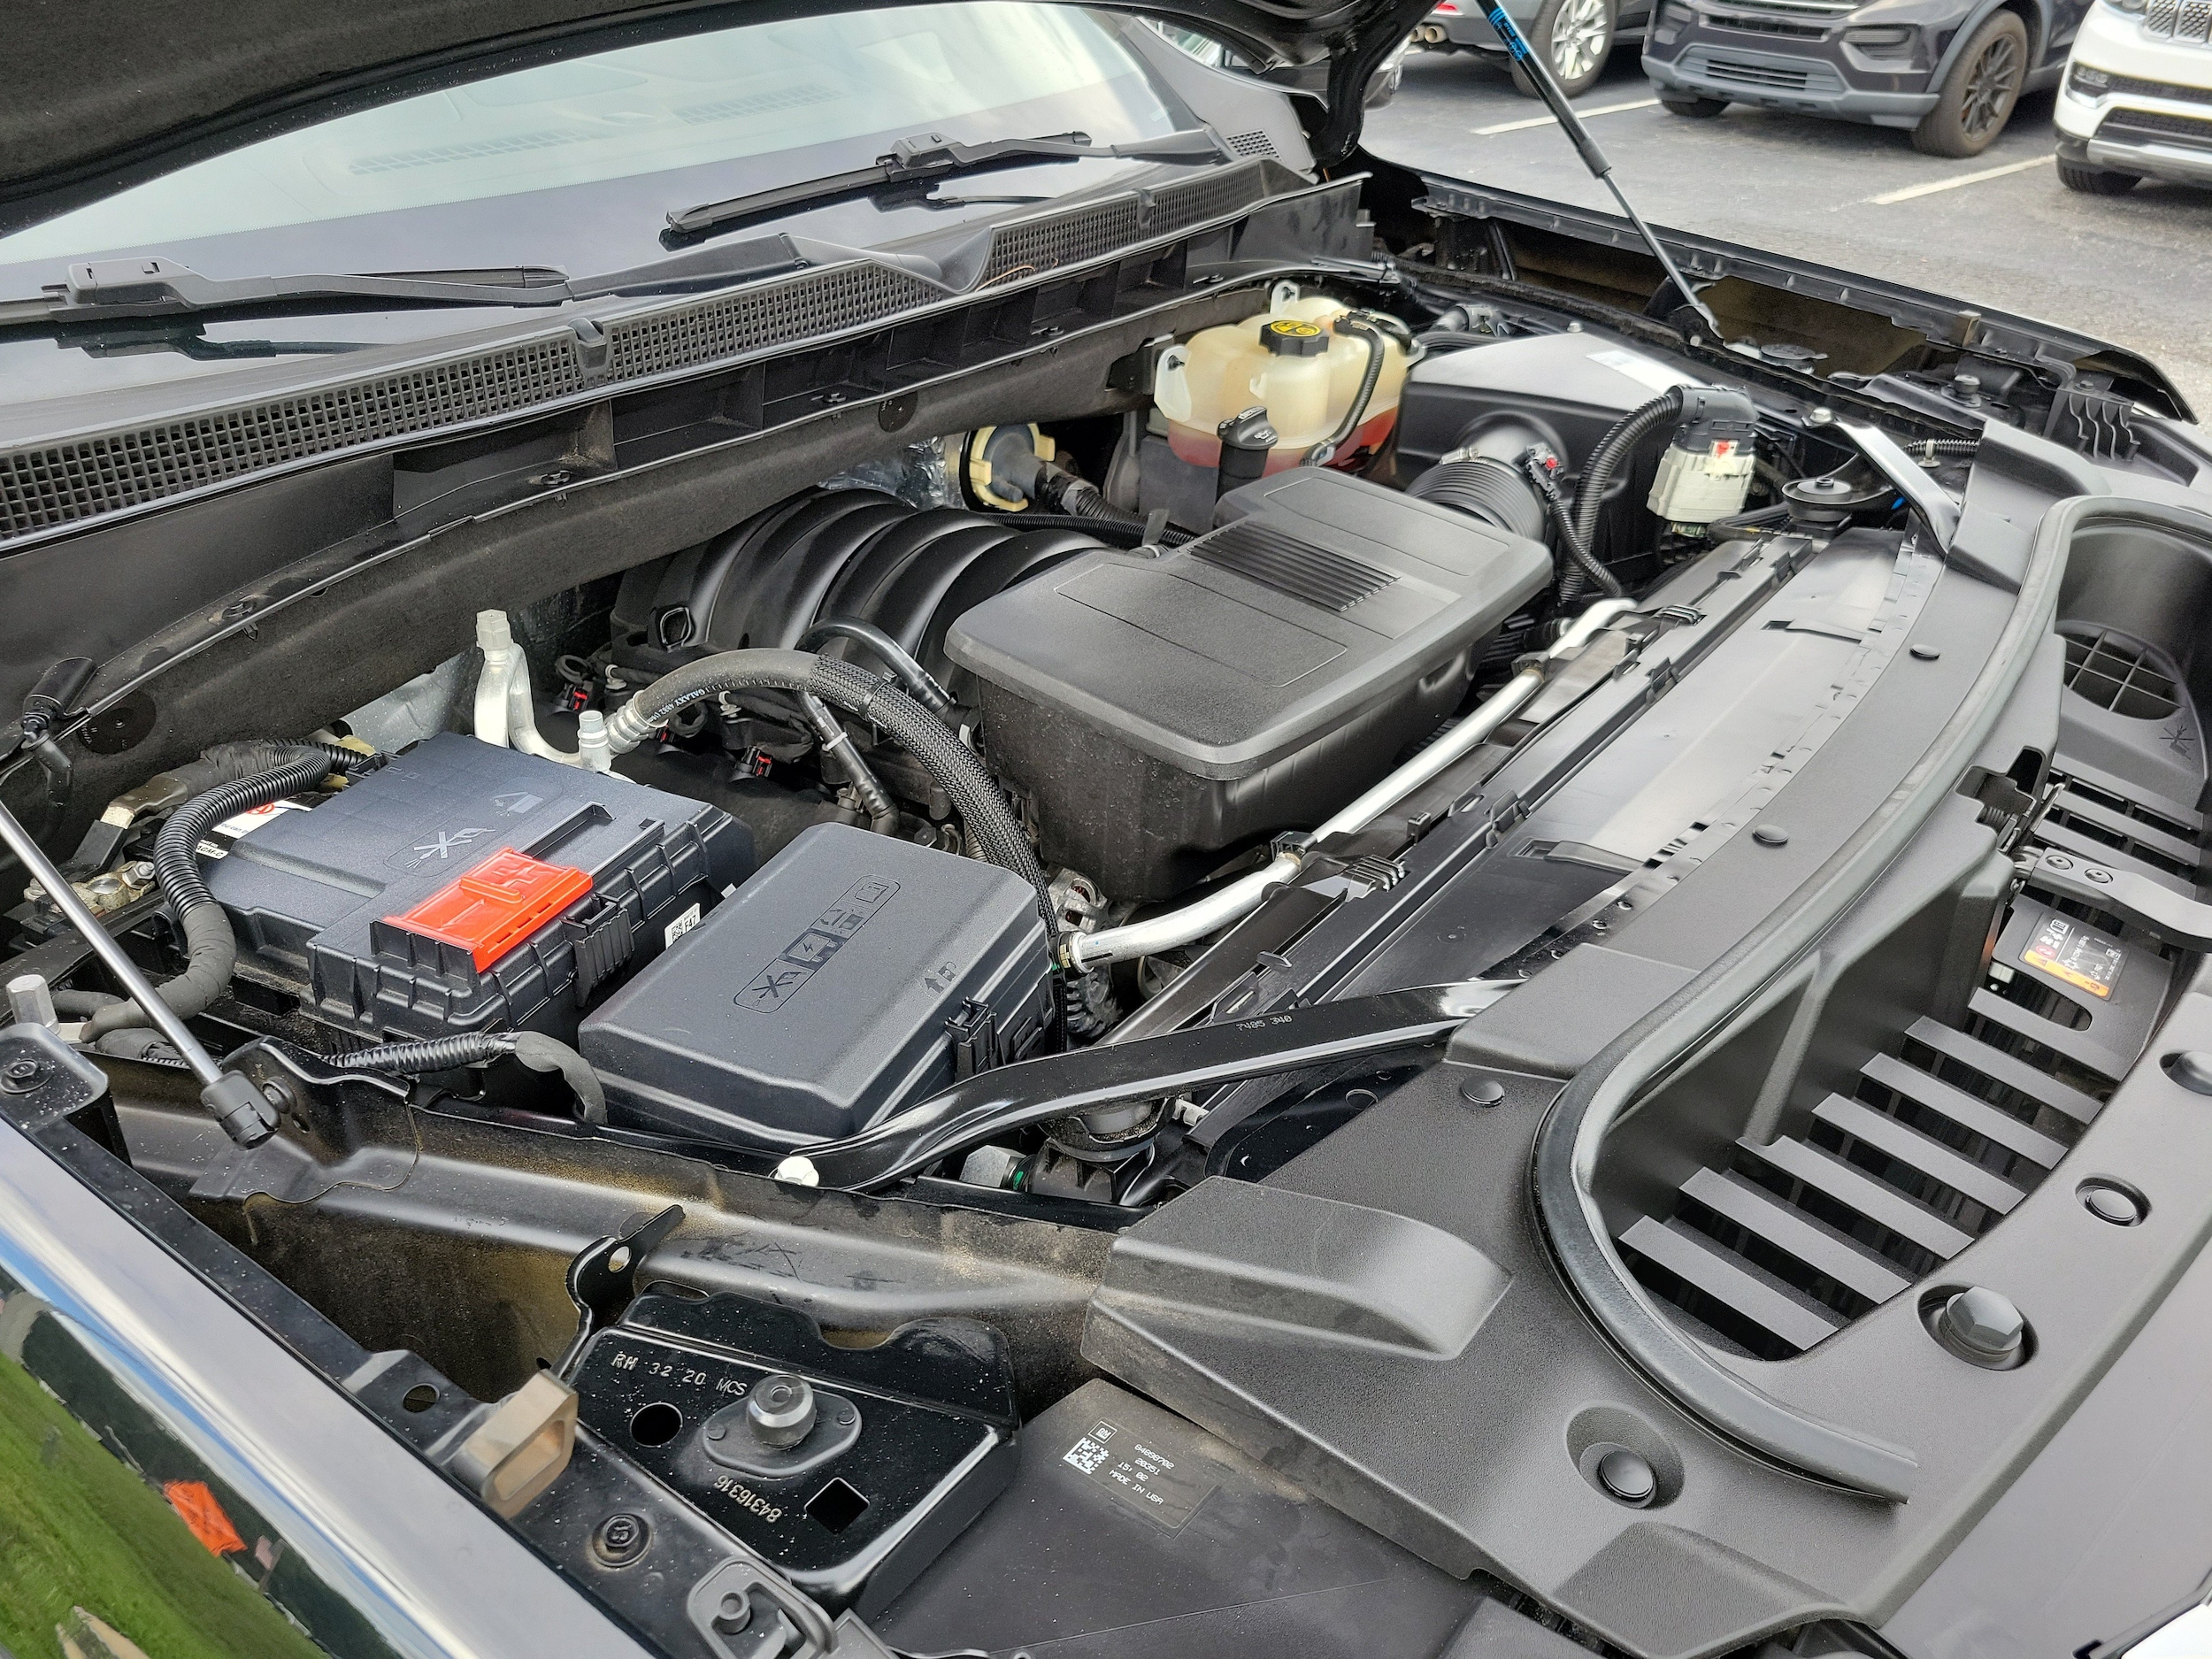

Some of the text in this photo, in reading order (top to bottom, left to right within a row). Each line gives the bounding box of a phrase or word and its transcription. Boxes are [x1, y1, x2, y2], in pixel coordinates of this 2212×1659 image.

[674, 688, 706, 706] GALAXY
[684, 915, 696, 932] F47
[611, 1353, 748, 1396] RH 32 20 MCS
[1134, 1457, 1161, 1476] 20351
[713, 1475, 782, 1523] 84316316
[1109, 1469, 1164, 1505] MADE IN USA
